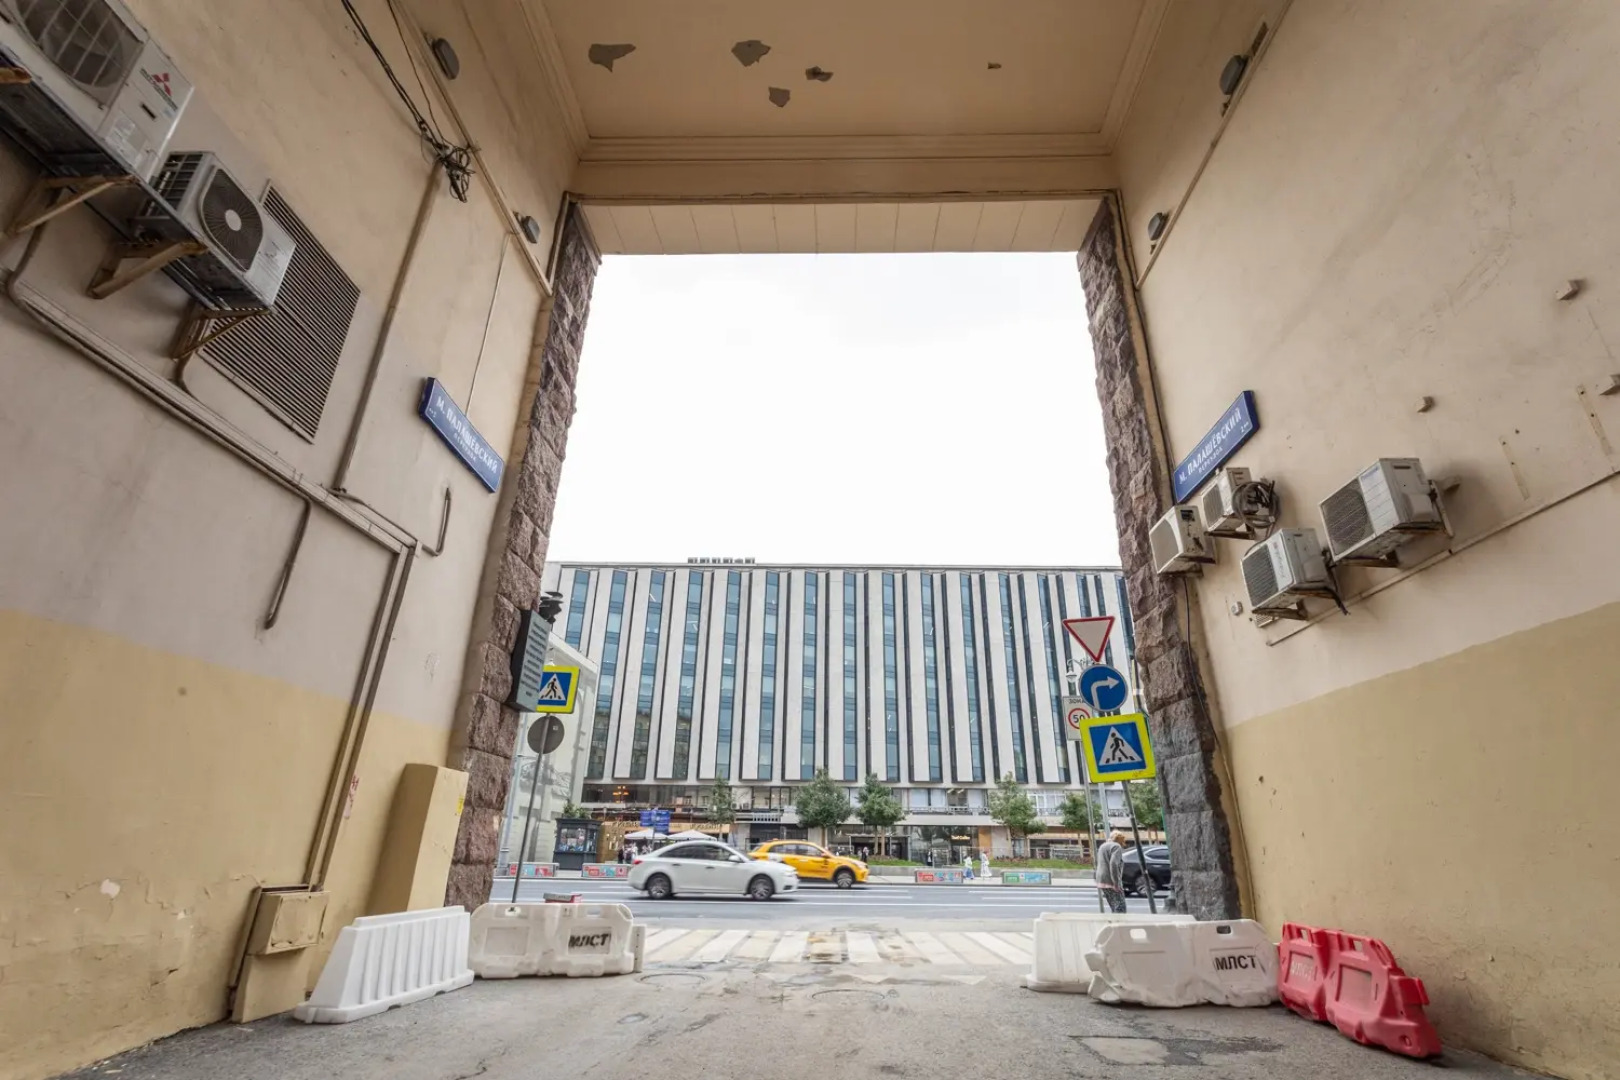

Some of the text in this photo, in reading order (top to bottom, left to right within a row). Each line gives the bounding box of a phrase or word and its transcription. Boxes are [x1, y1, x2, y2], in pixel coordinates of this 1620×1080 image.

[436, 396, 446, 414] М.
[1178, 407, 1242, 484] М. ПАЛАШЁВСКИЙ
[1073, 714, 1086, 723] 50
[1214, 955, 1256, 971] МЛСТ
